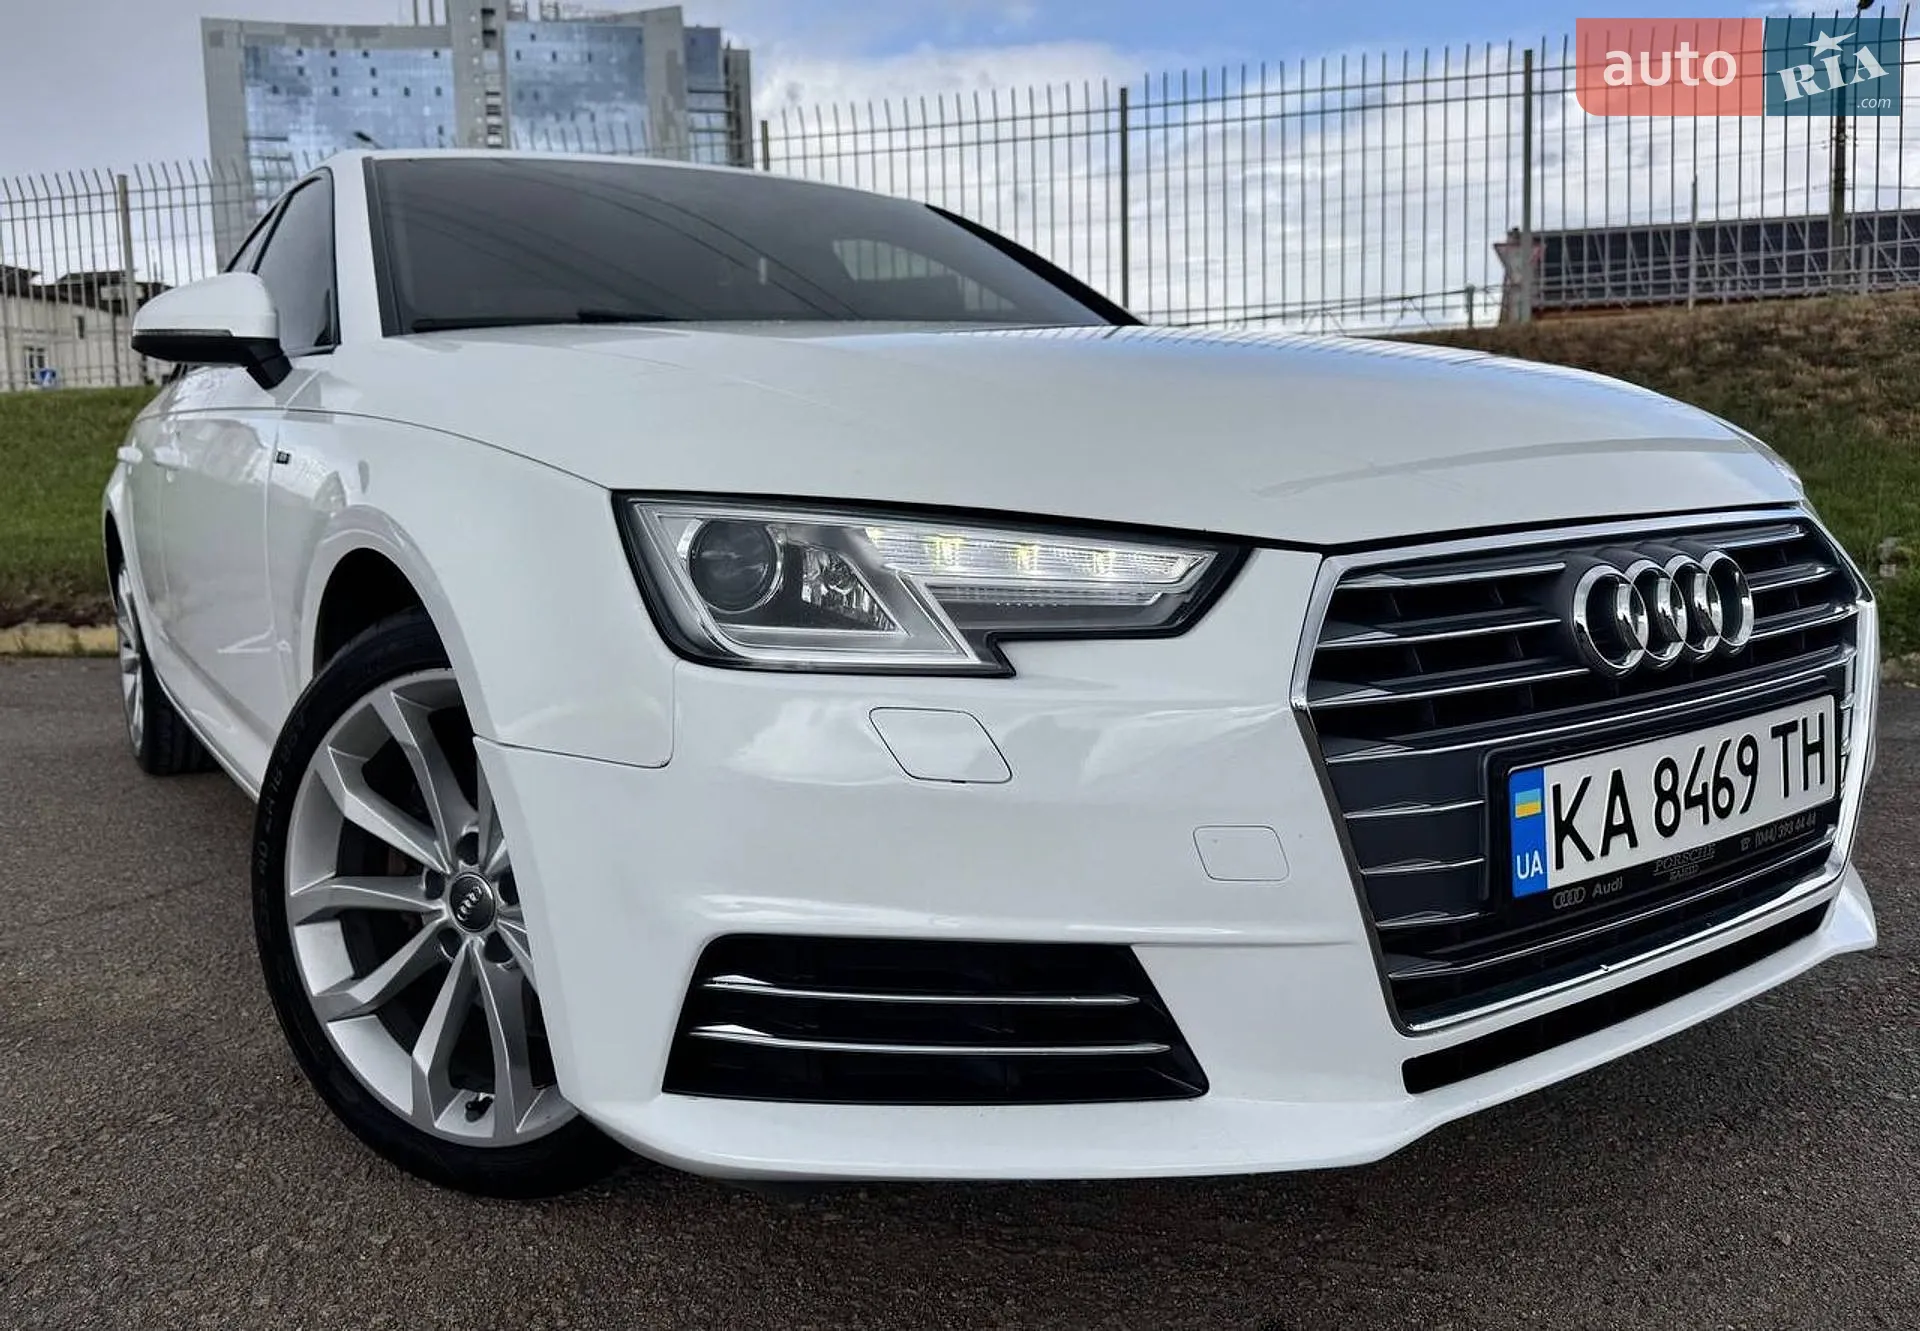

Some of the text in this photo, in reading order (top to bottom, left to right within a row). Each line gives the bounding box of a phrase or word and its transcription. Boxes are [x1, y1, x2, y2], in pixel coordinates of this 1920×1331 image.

[1552, 711, 1826, 870] KA 8469 TH
[1516, 850, 1544, 880] UA
[1592, 875, 1624, 899] Audi
